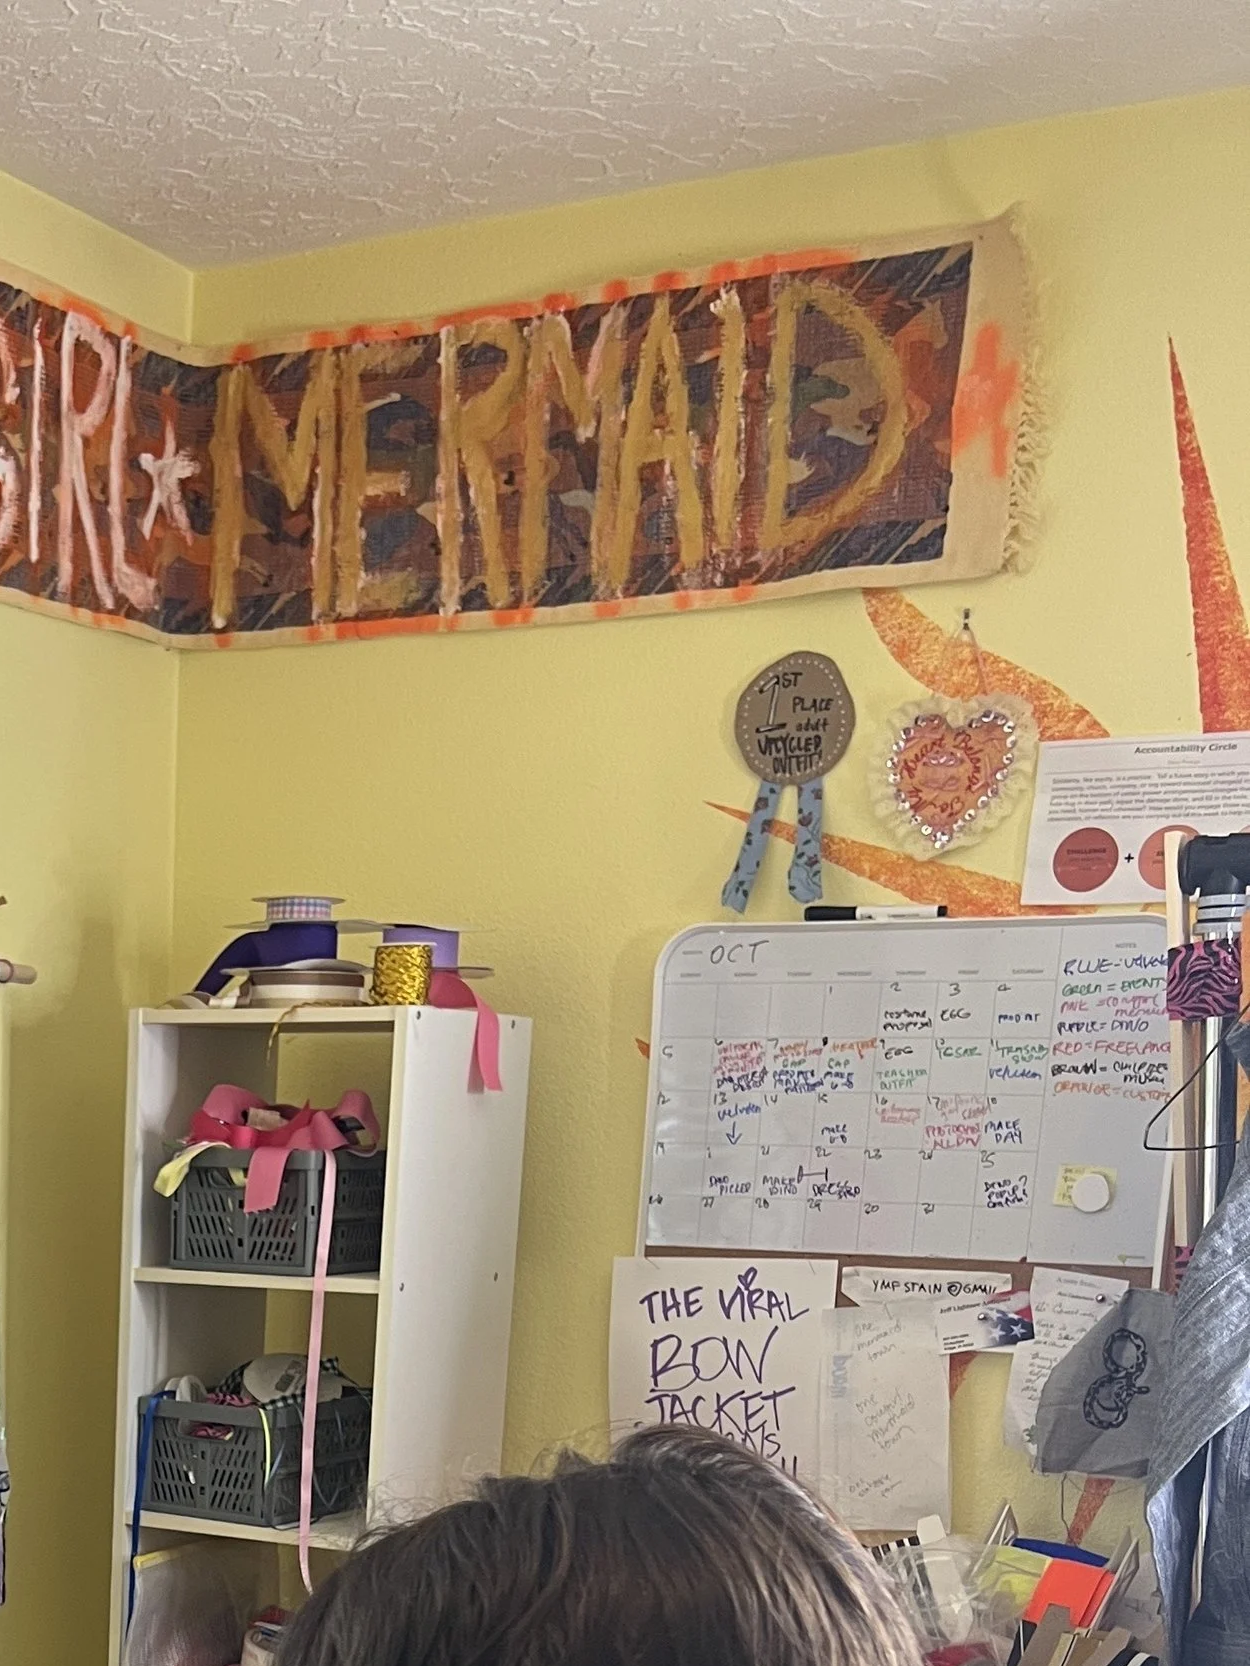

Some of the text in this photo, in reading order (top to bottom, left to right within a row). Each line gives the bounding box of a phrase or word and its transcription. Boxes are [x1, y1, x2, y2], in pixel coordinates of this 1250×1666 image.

[208, 274, 910, 630] MERMAID
[792, 696, 834, 714] PLACE
[1134, 743, 1238, 755] Accountability Circle
[710, 940, 769, 965] OCT
[890, 982, 902, 992] 2
[949, 982, 962, 997] 3
[767, 1038, 779, 1049] 7
[1053, 1041, 1083, 1056] RED
[713, 1091, 728, 1105] 13
[994, 1130, 1023, 1144] DAY
[903, 1281, 942, 1294] STAIN
[639, 1280, 810, 1324] THE VIRAL
[649, 1325, 779, 1392] BOW
[644, 1385, 796, 1436] JACKET
